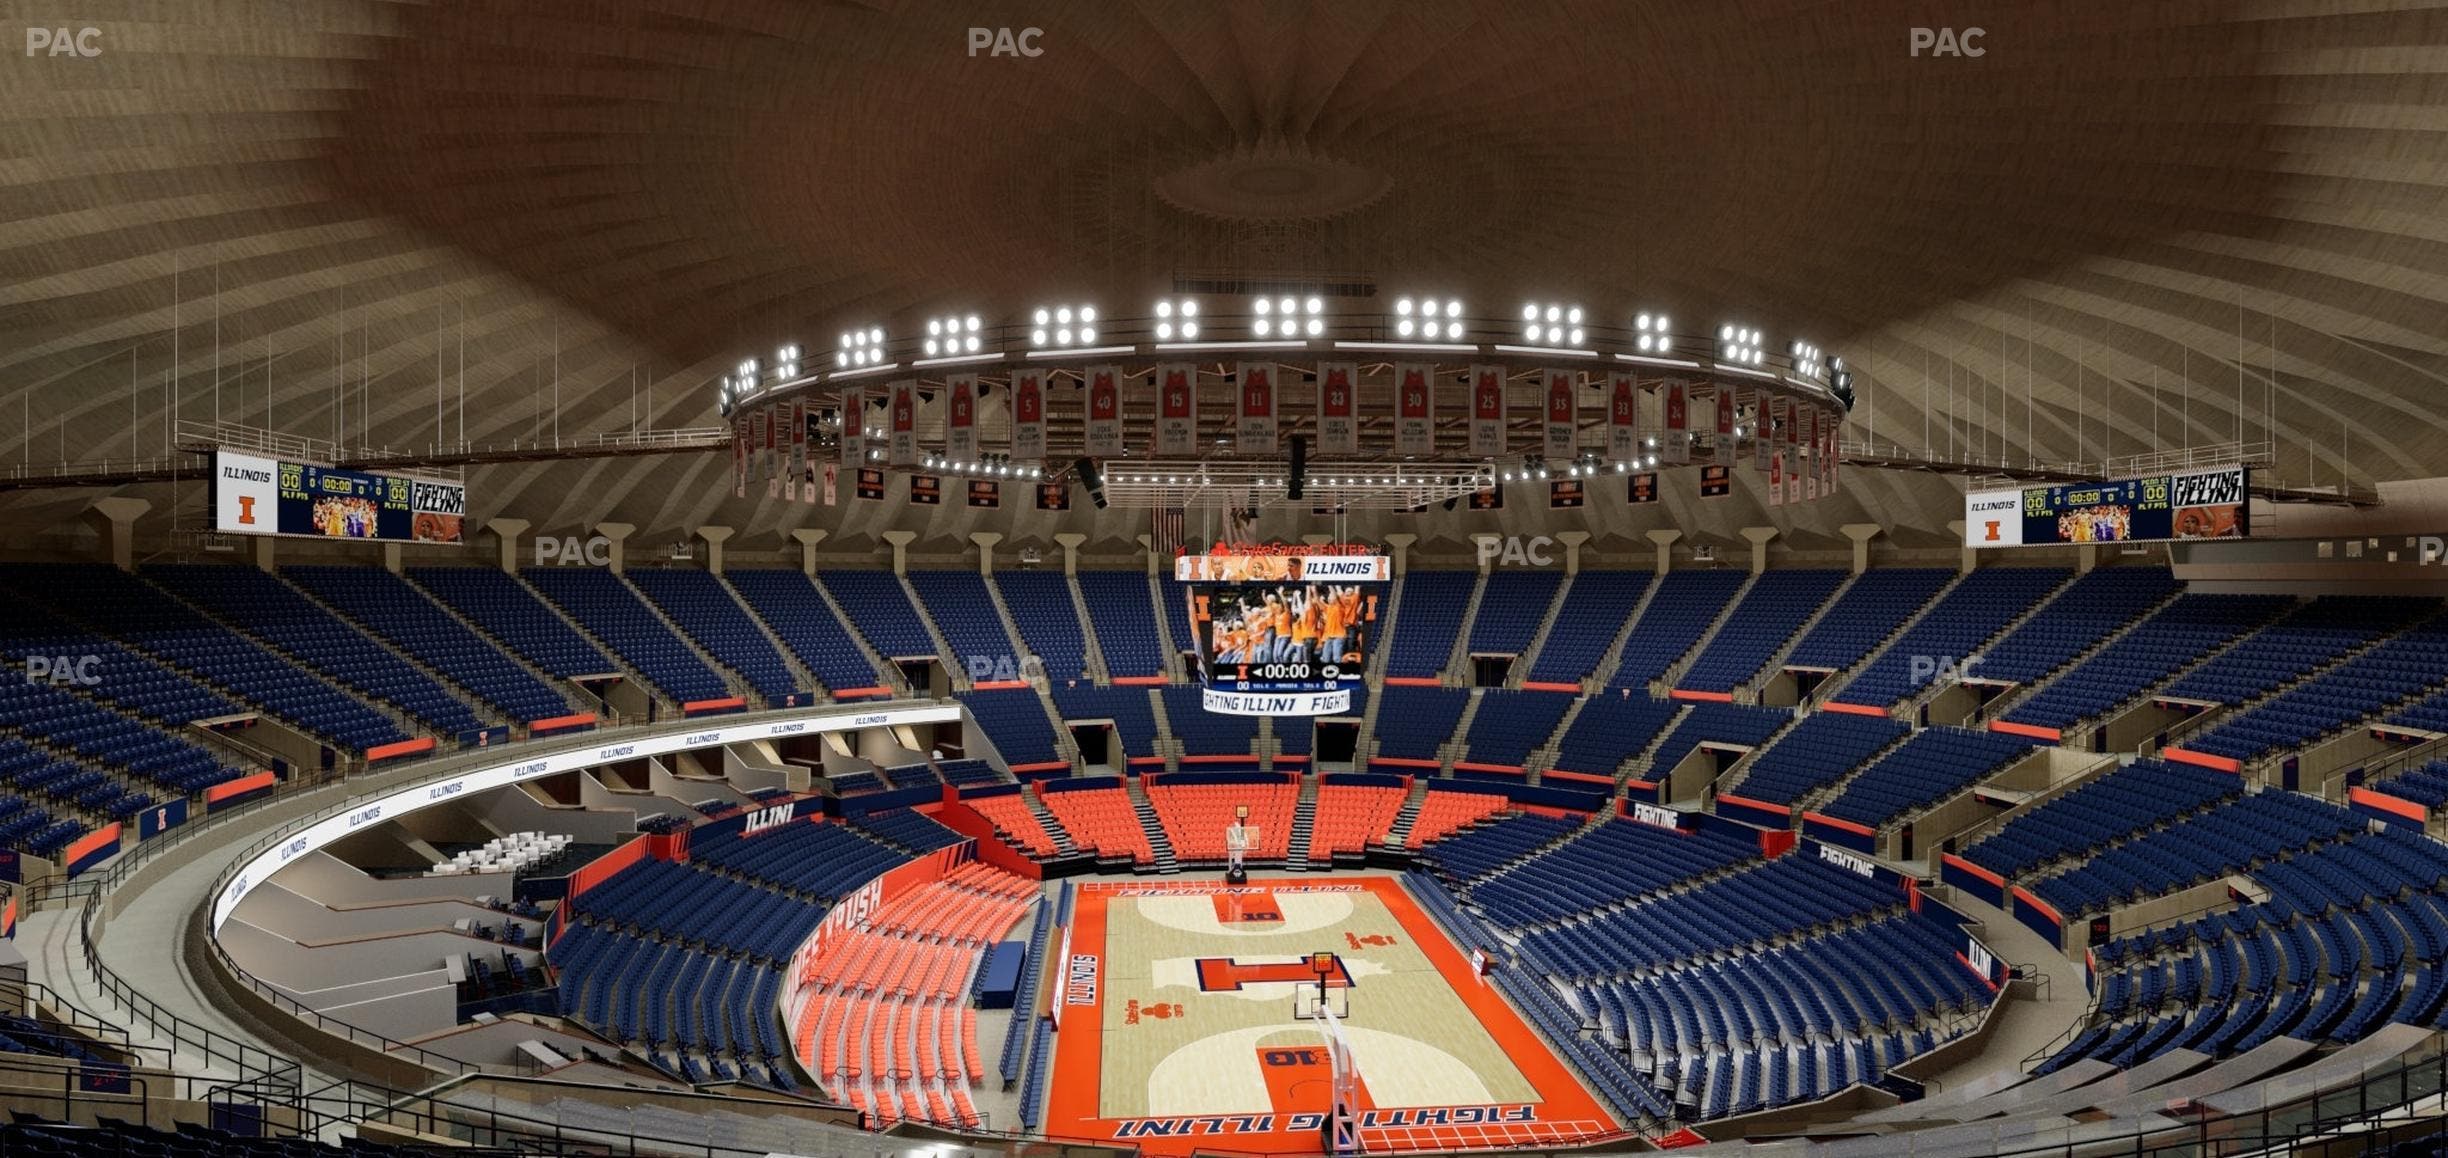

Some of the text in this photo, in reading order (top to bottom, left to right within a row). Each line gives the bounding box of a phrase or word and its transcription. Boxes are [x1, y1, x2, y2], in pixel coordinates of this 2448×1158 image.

[224, 466, 271, 483] ILLINOIS
[282, 474, 299, 487] 00
[2176, 471, 2241, 491] FIGHTING
[324, 479, 350, 491] 00:00
[414, 483, 463, 500] FIGHTING
[391, 487, 406, 500] 00
[2070, 492, 2099, 503] 00:00
[2146, 487, 2165, 499] 00
[1971, 501, 2015, 512] ILLINOIS
[2026, 498, 2043, 509] 00
[1306, 563, 1371, 575] ILLINOIS
[1265, 664, 1309, 678] 00:00
[1237, 681, 1249, 690] 00
[1324, 681, 1337, 690] 00
[1243, 698, 1297, 712] ILLINI
[855, 714, 888, 725] ILLINOIS
[771, 722, 805, 735] ILLINOIS
[686, 733, 720, 747] ILLINOIS
[600, 746, 634, 760] ILLINOIS
[514, 761, 547, 777] ILLINOIS
[429, 780, 463, 799] ILLINOIS
[350, 806, 381, 828] ILLINOIS
[745, 803, 796, 833] ILLINI
[1634, 803, 1678, 829] FIGHTING
[281, 836, 307, 862] ILLINOIS
[1820, 845, 1875, 879] FIGHTING
[1968, 938, 1992, 980] ILLINI
[1066, 954, 1098, 1006] ILLINOIS
[1113, 1106, 1538, 1138] FIGHTIG ILLINI
